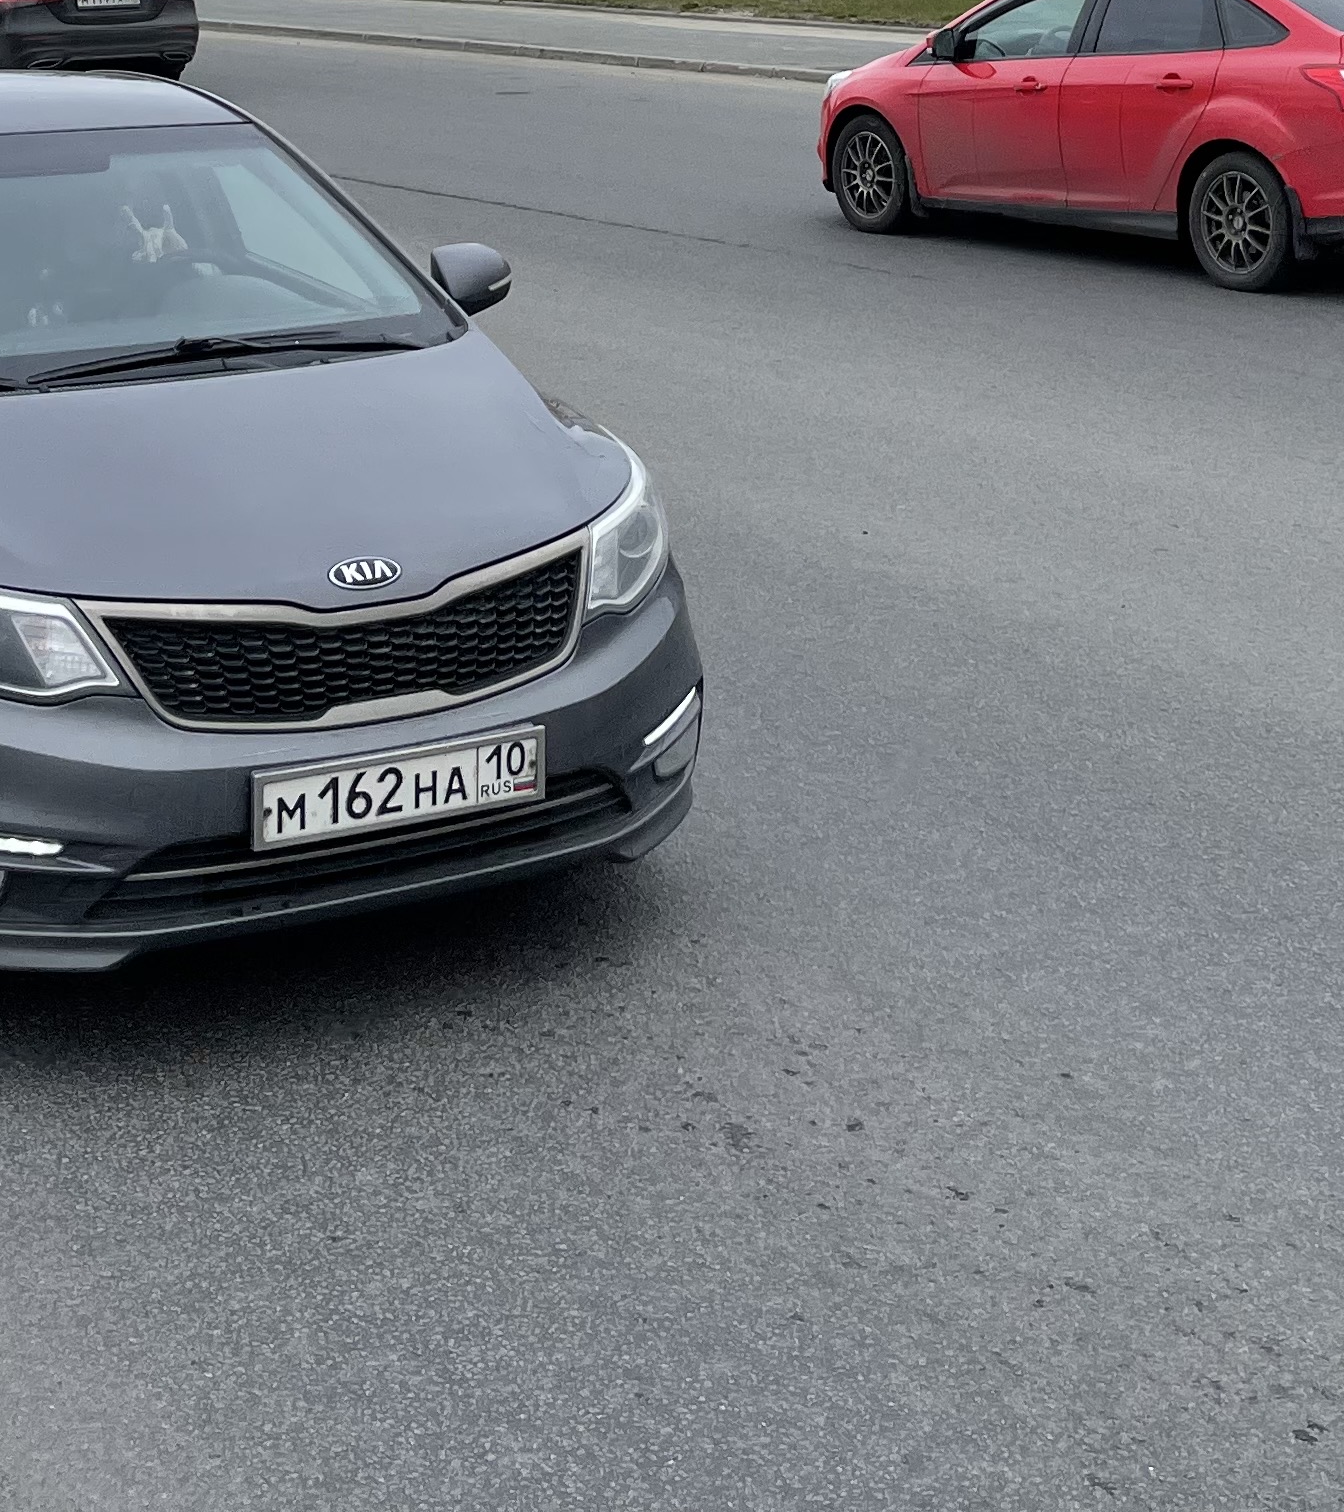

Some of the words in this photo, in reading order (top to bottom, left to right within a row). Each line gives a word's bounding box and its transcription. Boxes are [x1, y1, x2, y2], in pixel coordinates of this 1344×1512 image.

[339, 559, 393, 584] KIA
[485, 741, 526, 781] 10
[480, 782, 513, 798] RUS
